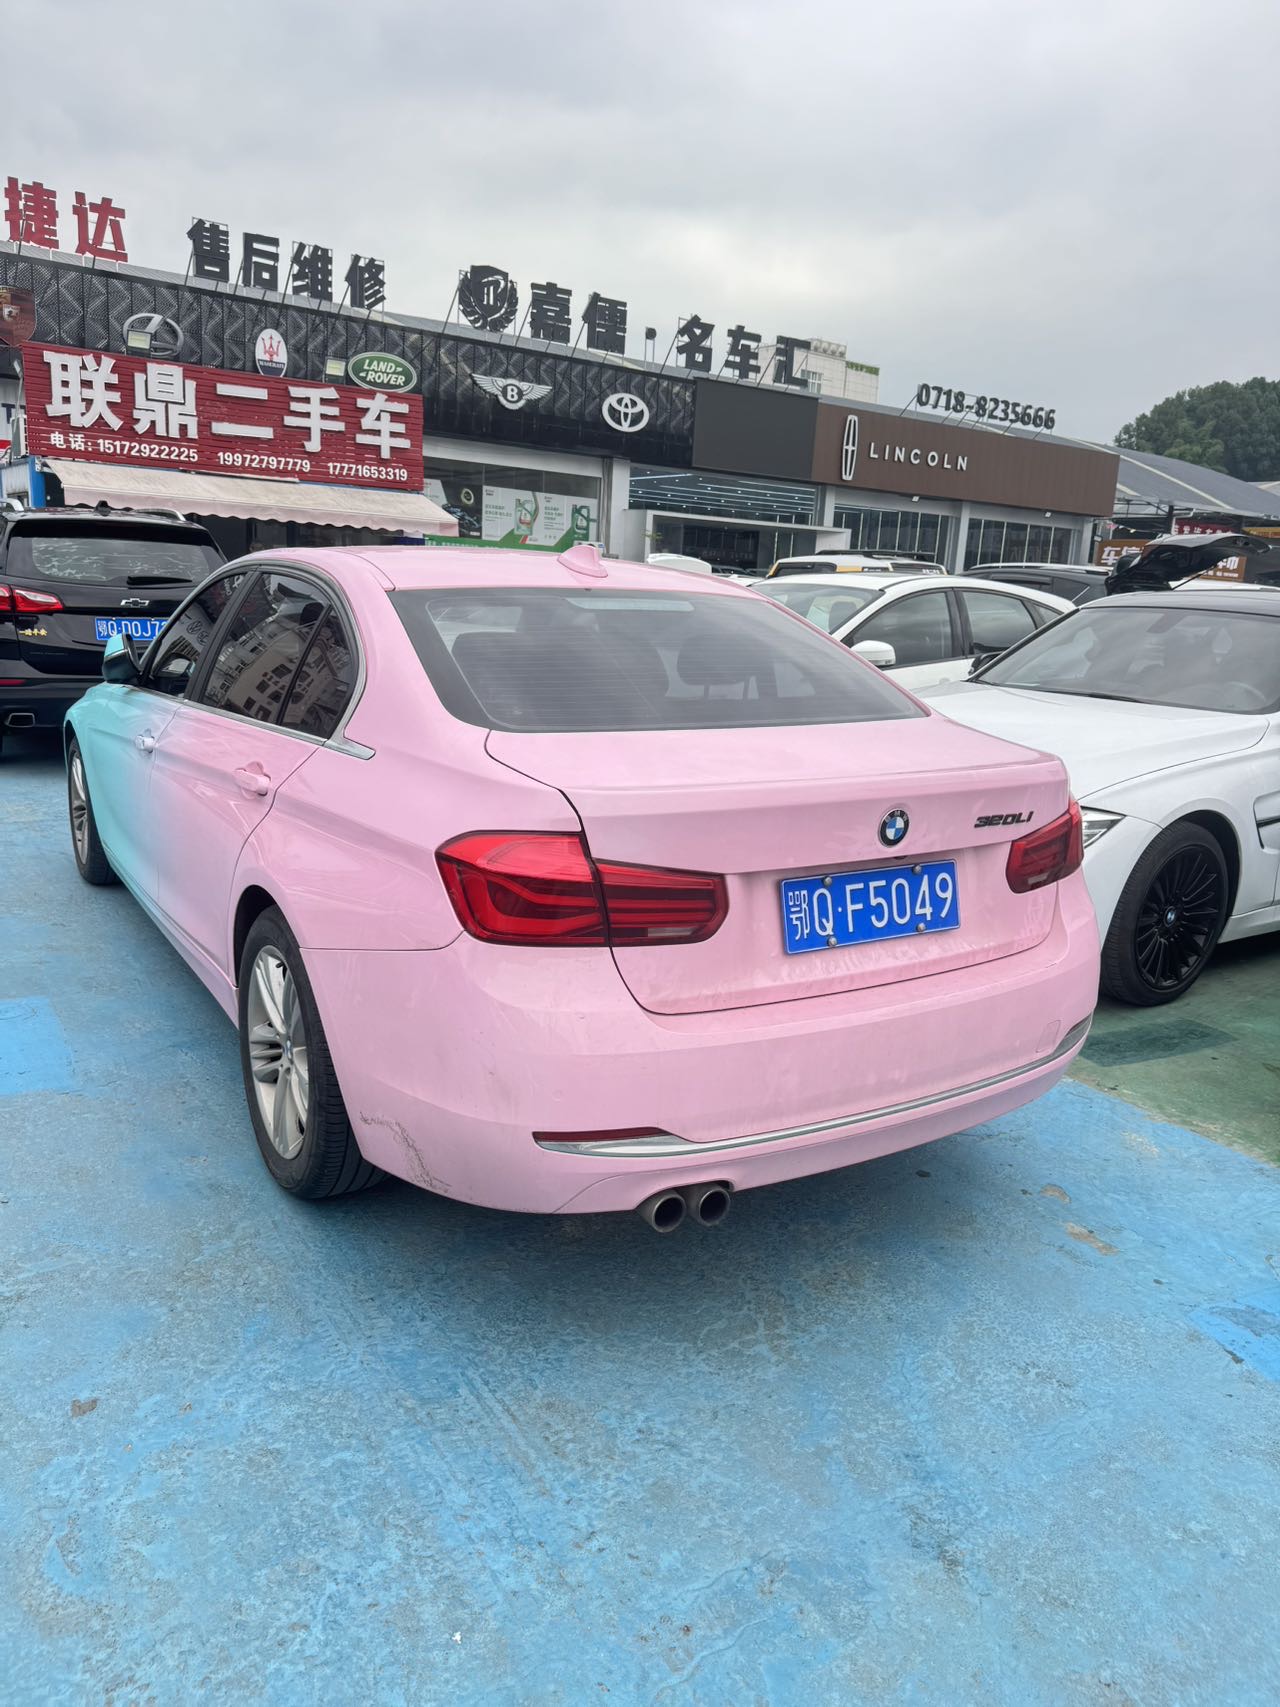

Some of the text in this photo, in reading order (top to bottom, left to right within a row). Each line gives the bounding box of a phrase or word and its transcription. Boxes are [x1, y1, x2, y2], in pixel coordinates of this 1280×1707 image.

[4, 176, 129, 263] 捷达
[186, 218, 386, 310] 售后维修
[363, 358, 395, 374] LAND
[365, 371, 406, 387] ROVER
[42, 350, 412, 460] 联鼎二手车
[917, 383, 1056, 430] 0718-8235666
[97, 439, 198, 462] 15172922225
[217, 451, 311, 473] 19972797779
[327, 462, 408, 482] 17771653319
[869, 442, 968, 471] LINCOLN
